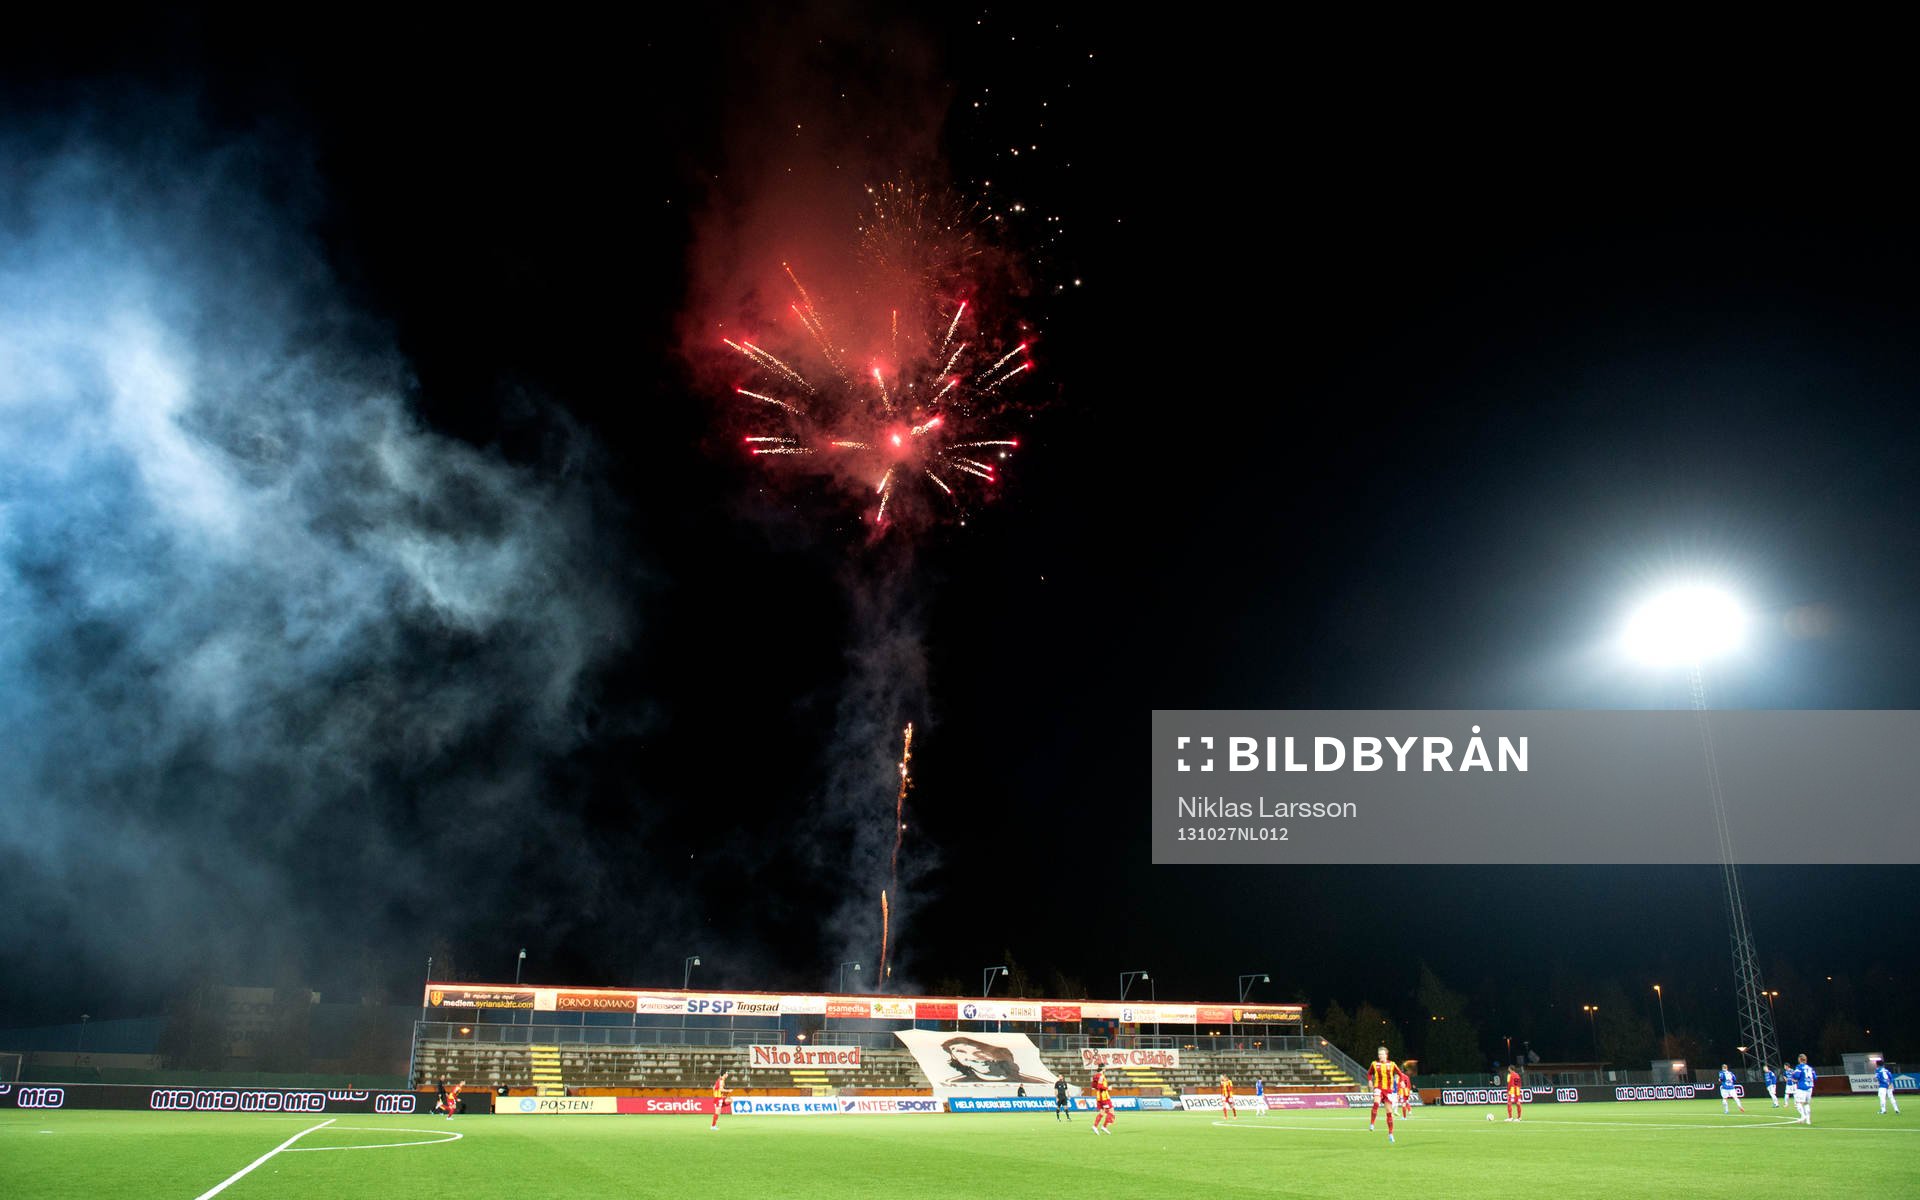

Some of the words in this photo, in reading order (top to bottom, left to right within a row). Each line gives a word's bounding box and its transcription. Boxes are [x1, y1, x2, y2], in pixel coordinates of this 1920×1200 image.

[559, 998, 591, 1008] FORNO
[593, 999, 634, 1008] ROMANO
[736, 1002, 779, 1012] Tingstad
[753, 1046, 791, 1064] Nio
[793, 1045, 816, 1064] år
[817, 1046, 860, 1064] med
[1111, 1053, 1128, 1064] av
[1129, 1050, 1174, 1067] Glädje
[540, 1099, 594, 1110] POSTEN!
[647, 1099, 702, 1111] Scandic
[755, 1102, 800, 1112] AKSAB
[805, 1102, 837, 1112] KEMI
[858, 1100, 937, 1111] INTERSPORT
